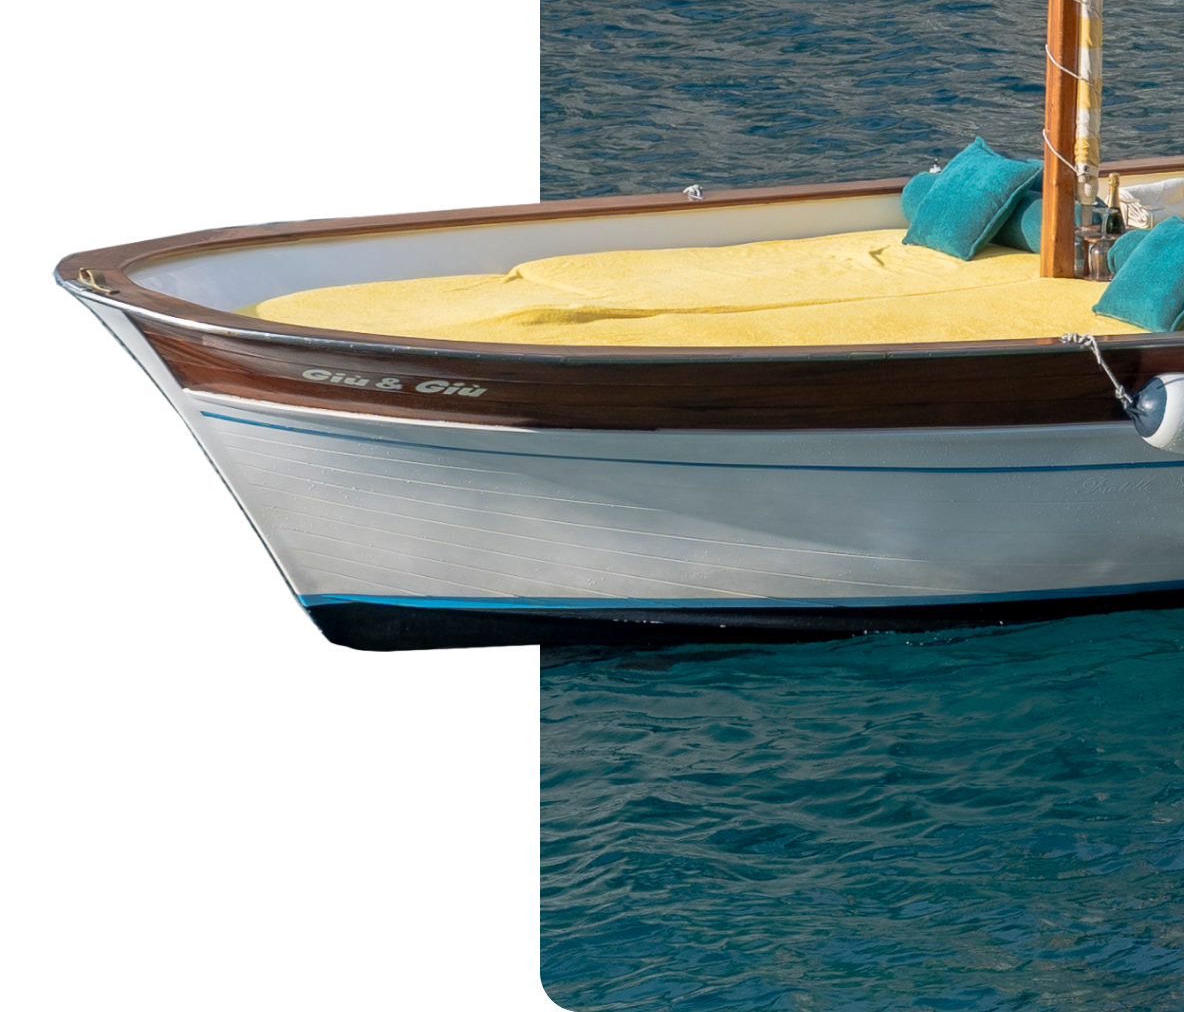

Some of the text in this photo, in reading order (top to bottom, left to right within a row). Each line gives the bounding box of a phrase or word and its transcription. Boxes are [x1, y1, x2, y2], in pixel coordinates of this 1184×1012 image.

[302, 369, 488, 397] Giù & Giù
